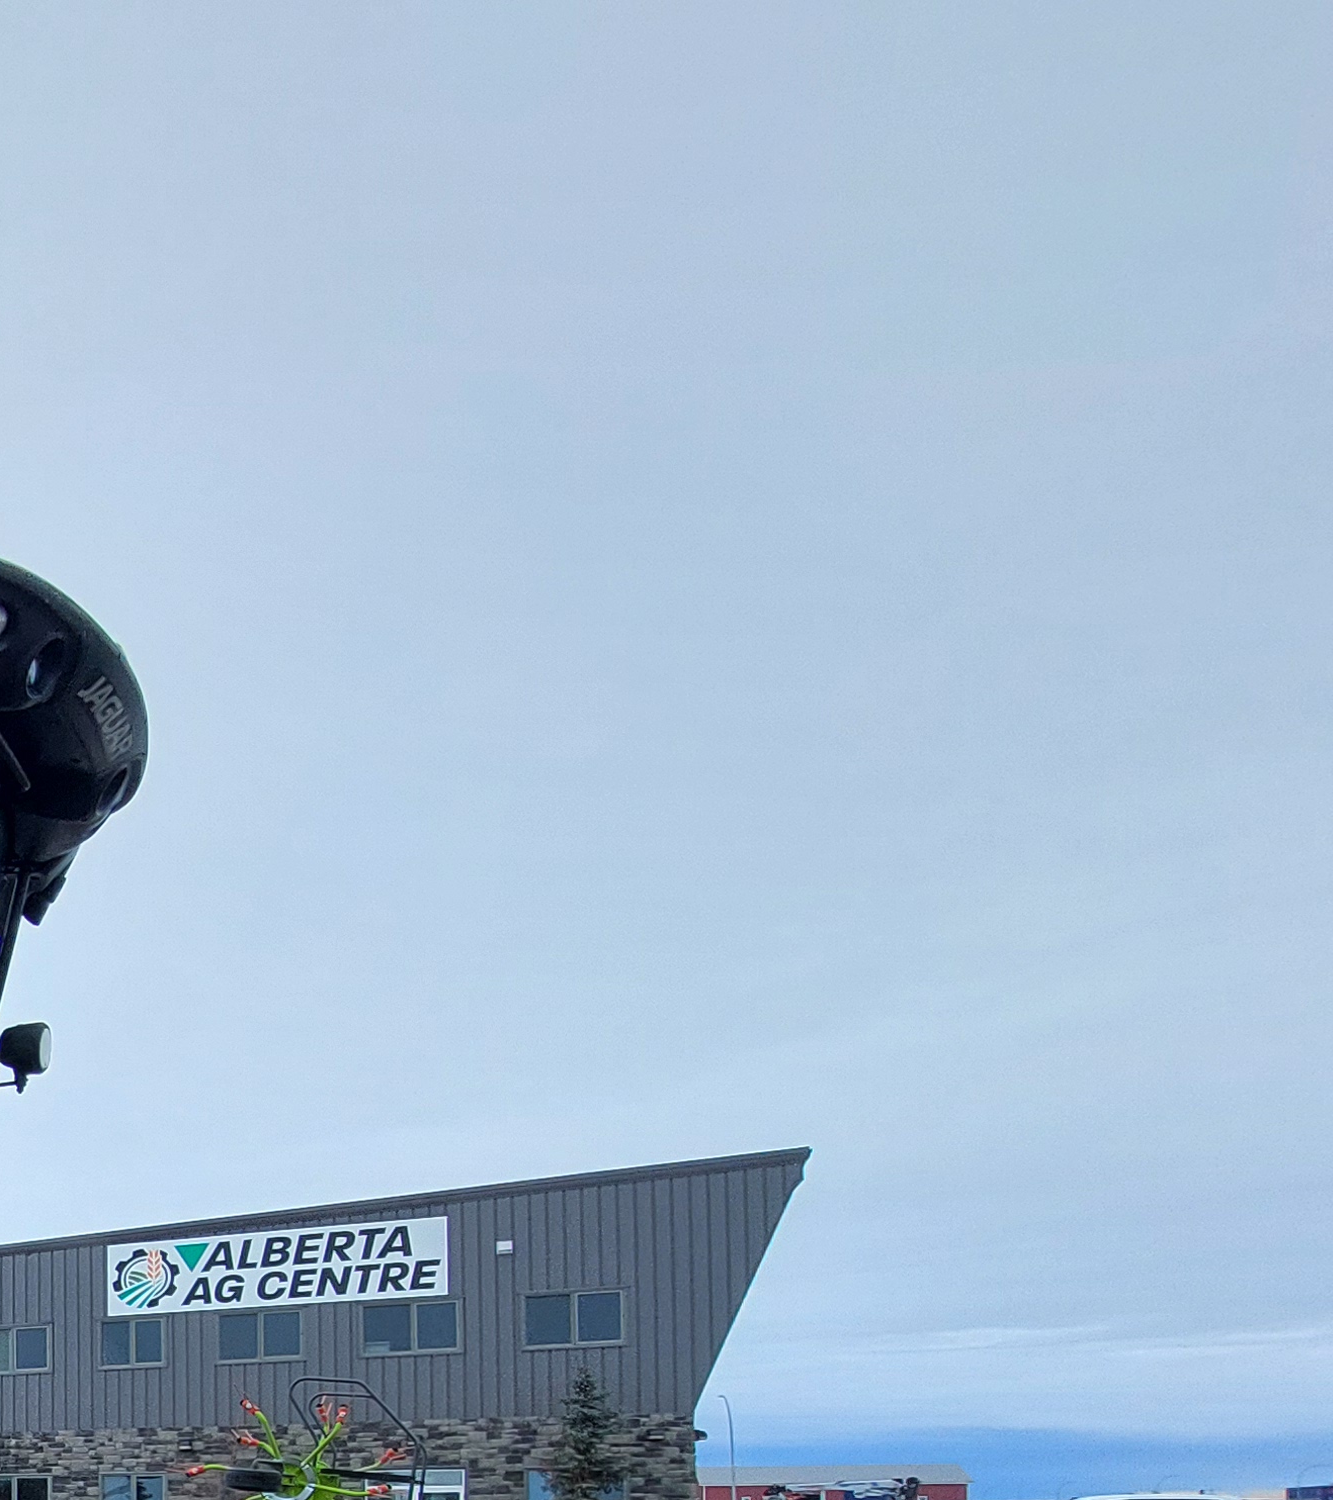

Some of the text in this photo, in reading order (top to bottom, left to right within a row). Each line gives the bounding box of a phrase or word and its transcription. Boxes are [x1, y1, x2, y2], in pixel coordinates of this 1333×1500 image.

[77, 676, 133, 760] JAGUAR
[201, 1225, 413, 1274] ALBERTA
[180, 1258, 442, 1306] AG CENTRE
